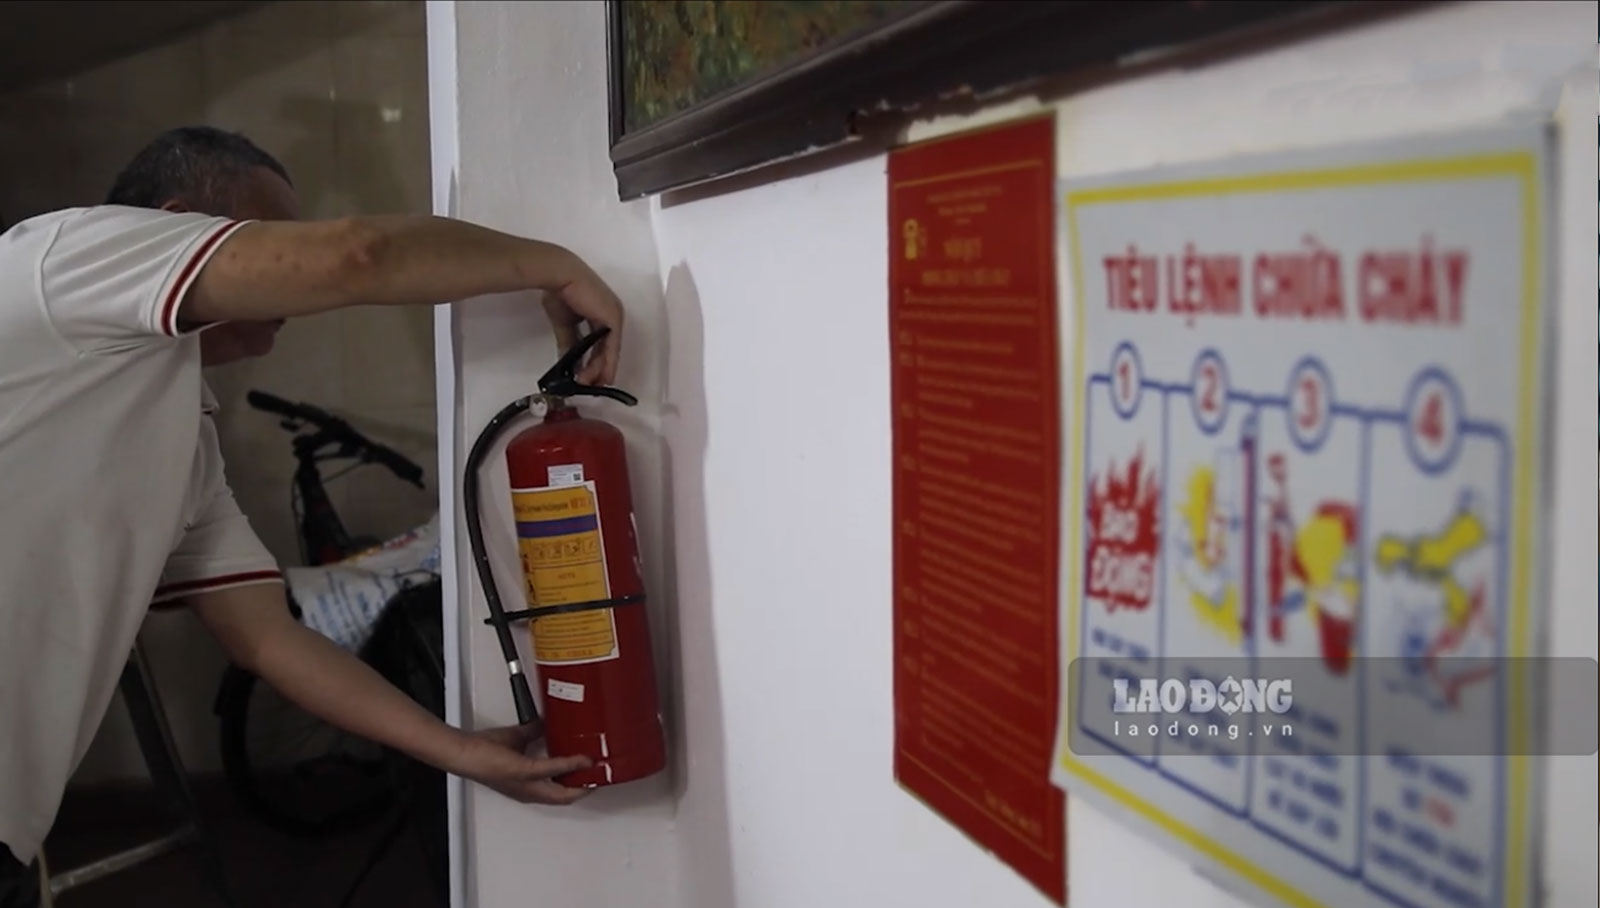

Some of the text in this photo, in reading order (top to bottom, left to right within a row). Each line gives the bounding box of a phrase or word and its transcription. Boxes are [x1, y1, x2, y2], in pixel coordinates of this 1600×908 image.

[1102, 244, 1158, 313] TIÊU
[1165, 242, 1243, 328] LỆNH
[1357, 234, 1470, 328] CHÁY
[1118, 361, 1131, 401] 1
[1201, 364, 1218, 412] 2
[1298, 376, 1321, 430] 3
[1415, 391, 1445, 444] 4
